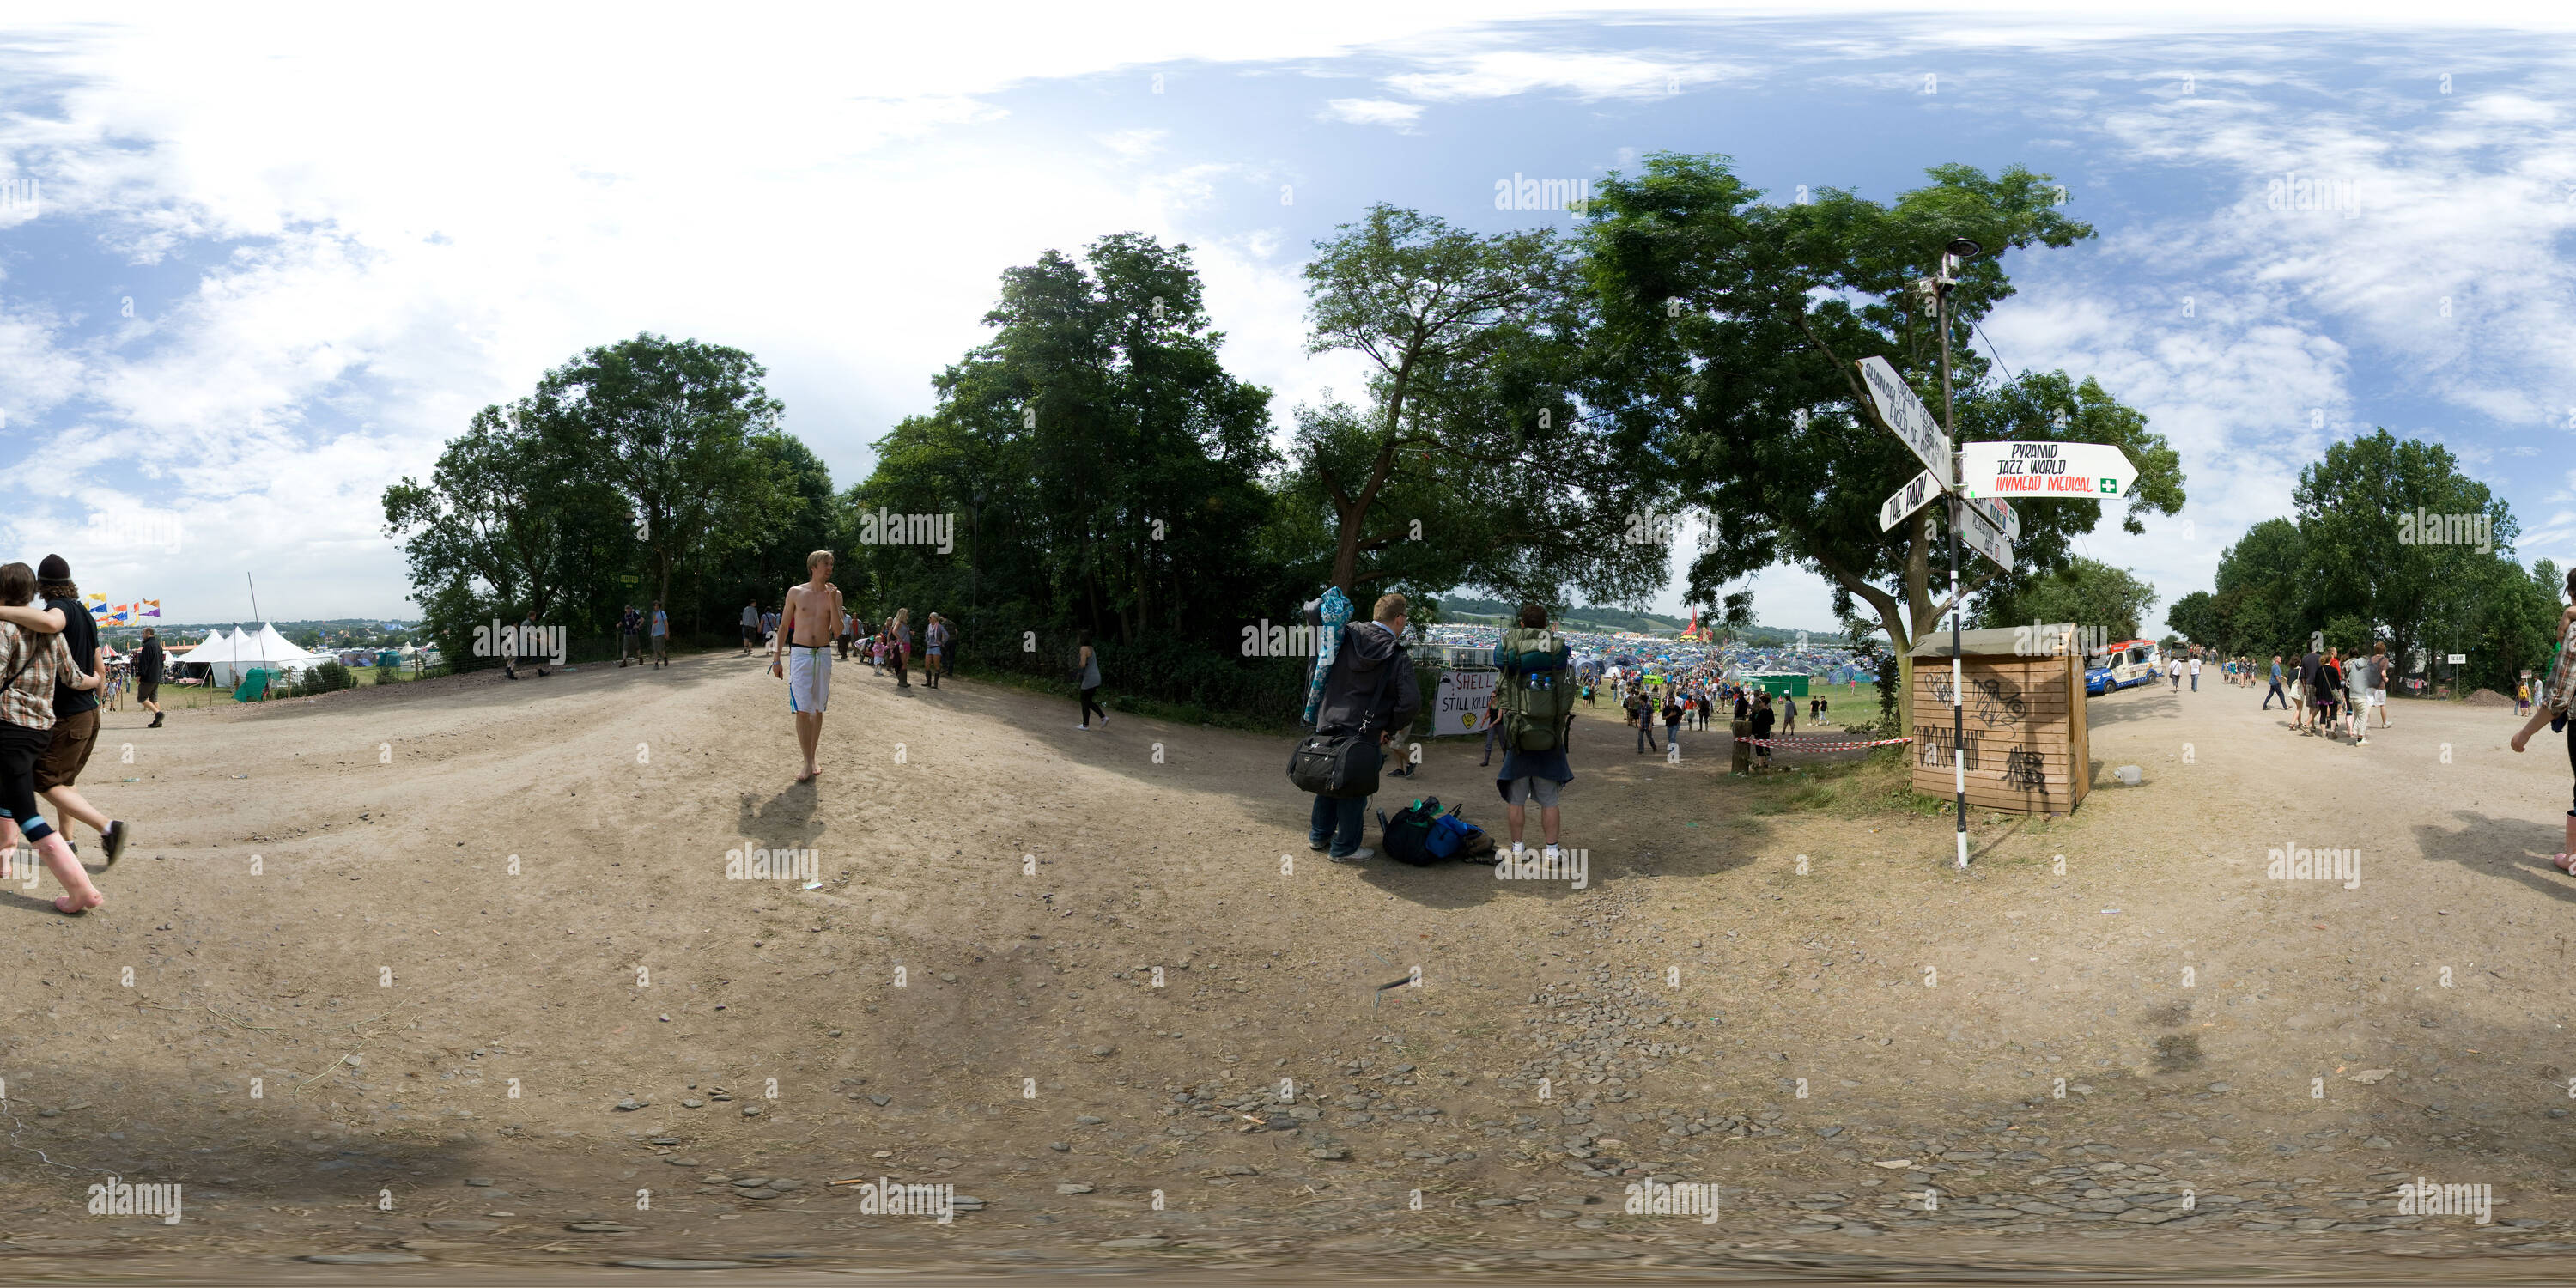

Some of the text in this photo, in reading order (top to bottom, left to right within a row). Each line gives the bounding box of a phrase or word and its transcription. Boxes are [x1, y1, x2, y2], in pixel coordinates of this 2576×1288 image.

[1897, 380, 1916, 410] GREEN
[1889, 404, 1908, 435] FIELD
[1910, 426, 1918, 446] OF
[2011, 443, 2058, 459] PYRAMID
[1997, 459, 2067, 475] JAZZ WORLD
[2047, 476, 2093, 492] MEDICAL
[1888, 472, 1928, 525] THE PARK
[1455, 673, 1492, 690] SHELL
[1443, 695, 1492, 712] STILL KILLI
